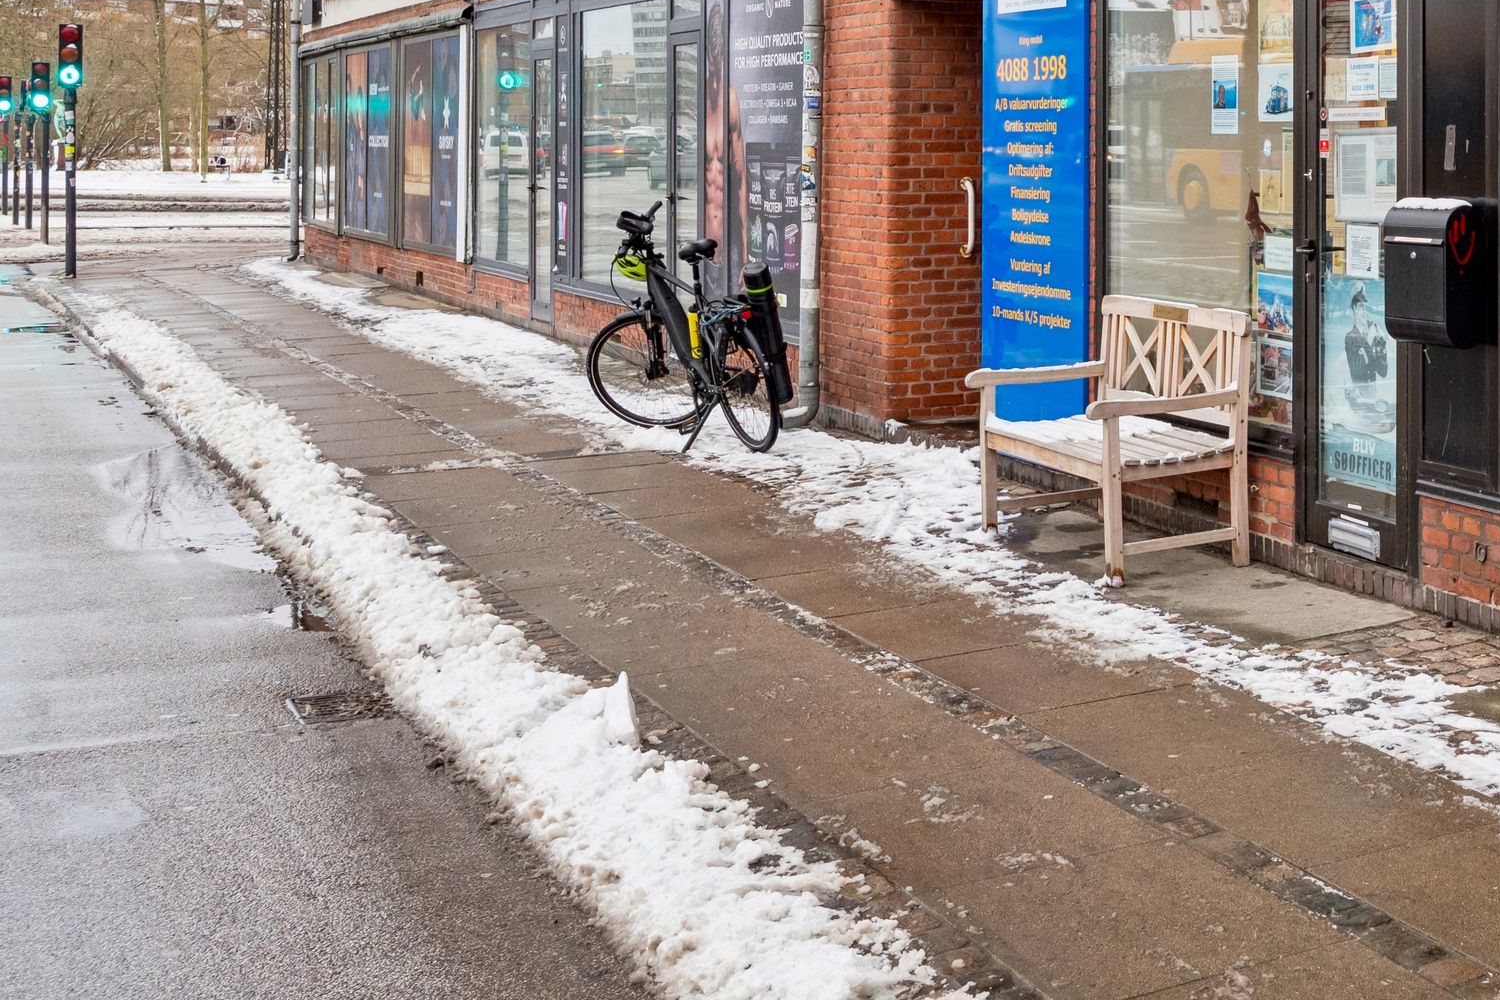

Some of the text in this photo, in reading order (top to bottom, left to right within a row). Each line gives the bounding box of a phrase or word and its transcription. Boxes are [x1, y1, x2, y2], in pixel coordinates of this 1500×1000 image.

[745, 1, 765, 13] ORGANIC
[734, 31, 804, 51] HIGH QUALITY PRODUCTS
[734, 51, 804, 70] FOR HIGH PERFORMANCE
[996, 54, 1067, 82] 4088 1998
[995, 95, 1068, 112] A/B valuarvurderinger
[1004, 119, 1057, 135] Gratis screening
[1007, 142, 1054, 157] Optimering af:
[1008, 164, 1053, 180] Driftsudgifter
[1010, 186, 1051, 203] Finansiering
[763, 200, 783, 213] PROTEIN
[1011, 208, 1050, 225] Boligydelse
[1010, 230, 1051, 246] Andelskrone
[1010, 258, 1051, 276] Vurdering af
[991, 278, 1071, 300] Investeringsejendomme
[992, 305, 1071, 329] 10-mands K/S projekter
[1352, 438, 1377, 456] BLIV
[1334, 451, 1392, 481] SØOFFICER
